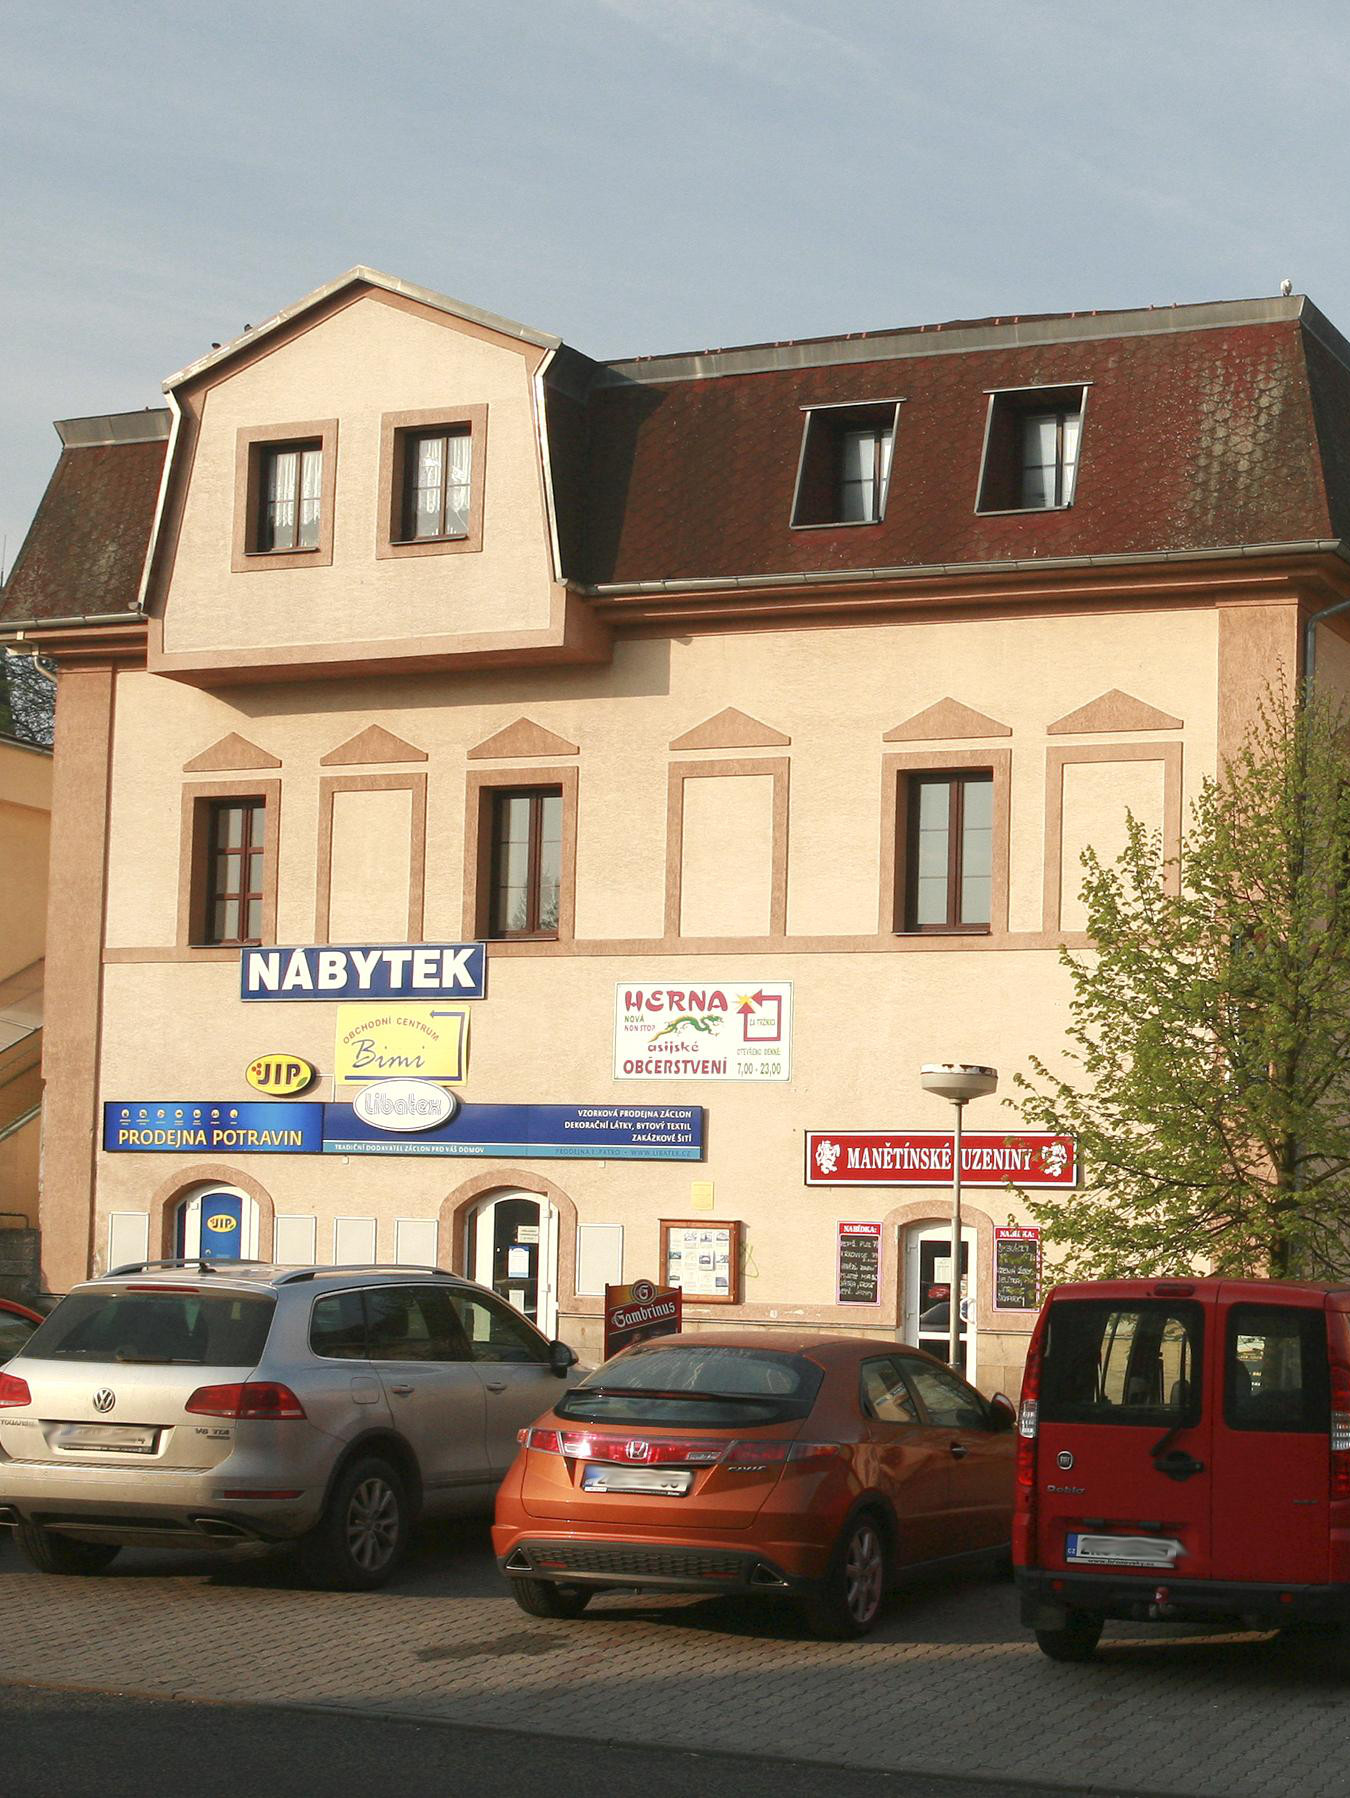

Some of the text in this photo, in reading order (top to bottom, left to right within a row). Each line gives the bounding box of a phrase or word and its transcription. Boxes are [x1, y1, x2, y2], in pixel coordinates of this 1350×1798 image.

[248, 948, 476, 991] NÁBYTEK
[624, 990, 728, 1012] HERNA
[624, 1013, 645, 1023] NOVÁ
[343, 1017, 439, 1044] OBCHODNÍ CENTRUM
[624, 1024, 639, 1032] NON
[352, 1038, 425, 1069] Bimi
[647, 1041, 699, 1054] asijské
[623, 1056, 727, 1075] OBČERSTVENÍ
[737, 1063, 754, 1077] 7,00
[760, 1062, 782, 1077] 23,00
[257, 1063, 301, 1086] JIP
[577, 1109, 692, 1119] VZORKOVÁ PRODEJNA ZÁCLON
[564, 1120, 692, 1130] DEKORAČNÍ LÁTKY, BYTOVÝ TEXTIL
[118, 1129, 303, 1148] PRODEJNA POTRAVIN
[632, 1133, 692, 1142] ZAKÁZKOVÉ ŠITÍ
[366, 1144, 403, 1152] DODAVATEL
[404, 1145, 431, 1153] ZÁCLON
[847, 1142, 1032, 1171] MANĚTÍNSKÉ UZENINY
[213, 1218, 232, 1228] JIP
[844, 1224, 878, 1233] NABÍDKA:
[611, 1301, 676, 1328] Gambrinus
